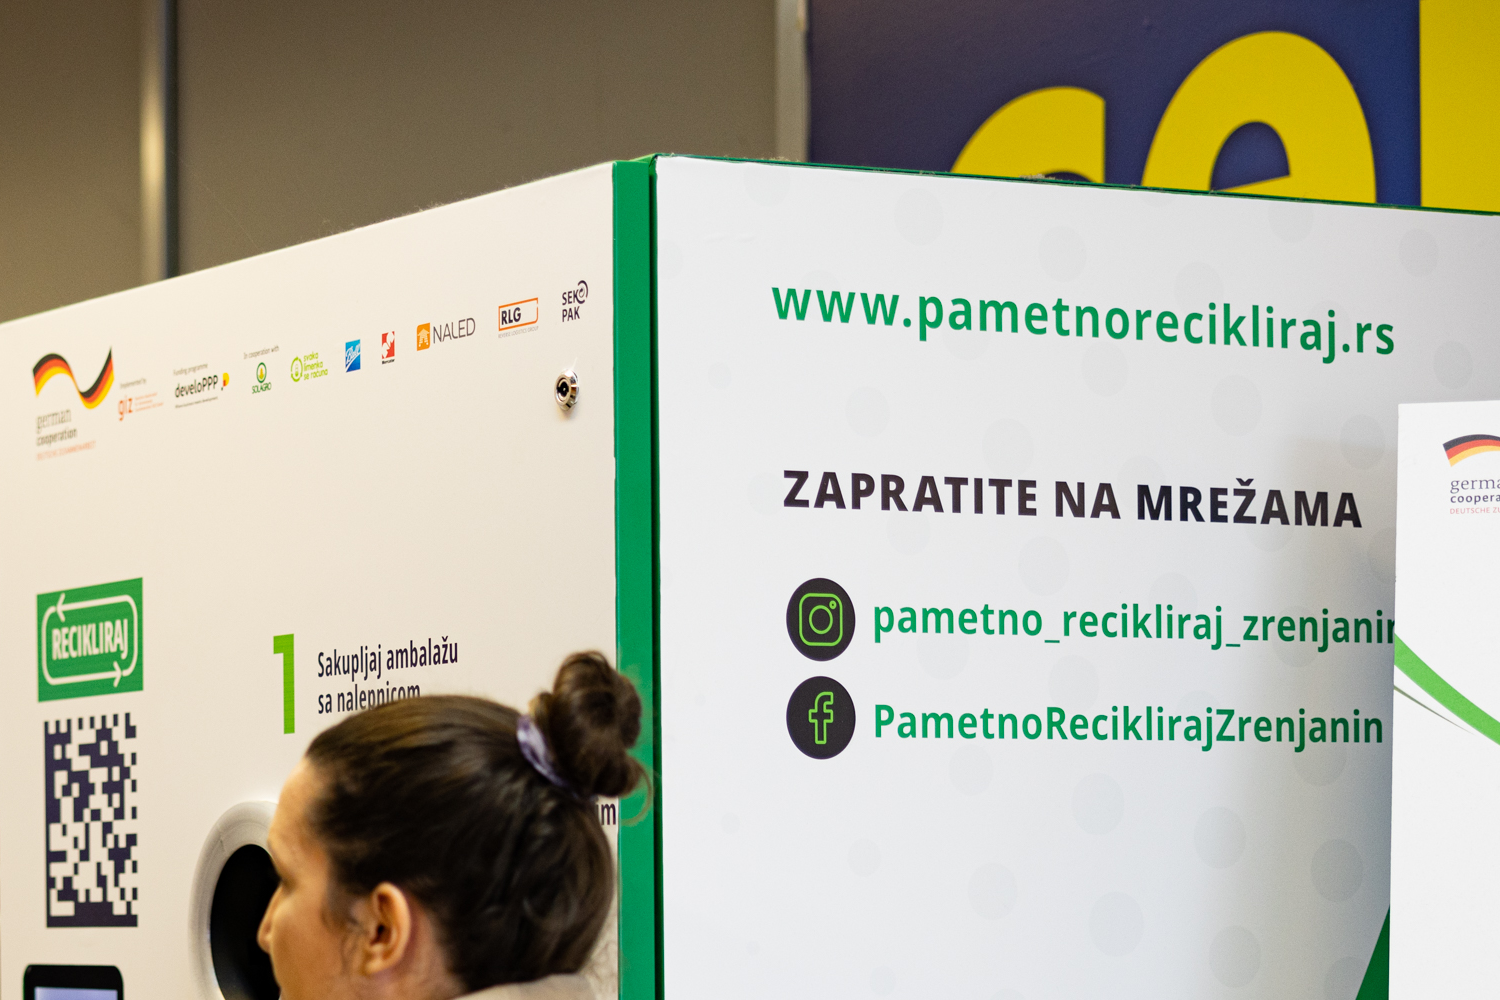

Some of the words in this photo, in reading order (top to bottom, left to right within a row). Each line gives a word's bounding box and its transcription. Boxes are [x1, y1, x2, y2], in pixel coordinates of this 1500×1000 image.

[501, 307, 522, 326] RLG
[562, 306, 581, 323] PAK
[771, 286, 1395, 365] www.pametnorecikliraj.rs
[433, 317, 476, 344] NALED
[175, 374, 219, 398] develoPPP
[252, 382, 272, 394] SOLAGRO
[118, 395, 133, 421] giz
[36, 409, 72, 434] german
[36, 428, 77, 447] cooperation
[783, 469, 1037, 517] ZAPRATITE
[1055, 480, 1121, 520] NA
[1136, 477, 1363, 529] MREŽAMA
[52, 618, 128, 660] RECIKLIRAJ
[318, 644, 382, 682] Sakupljaj
[386, 635, 458, 672] ambalažu
[273, 633, 295, 734] 1
[318, 692, 332, 714] sa
[874, 704, 1384, 752] PametnoReciklirajZrenjanin
